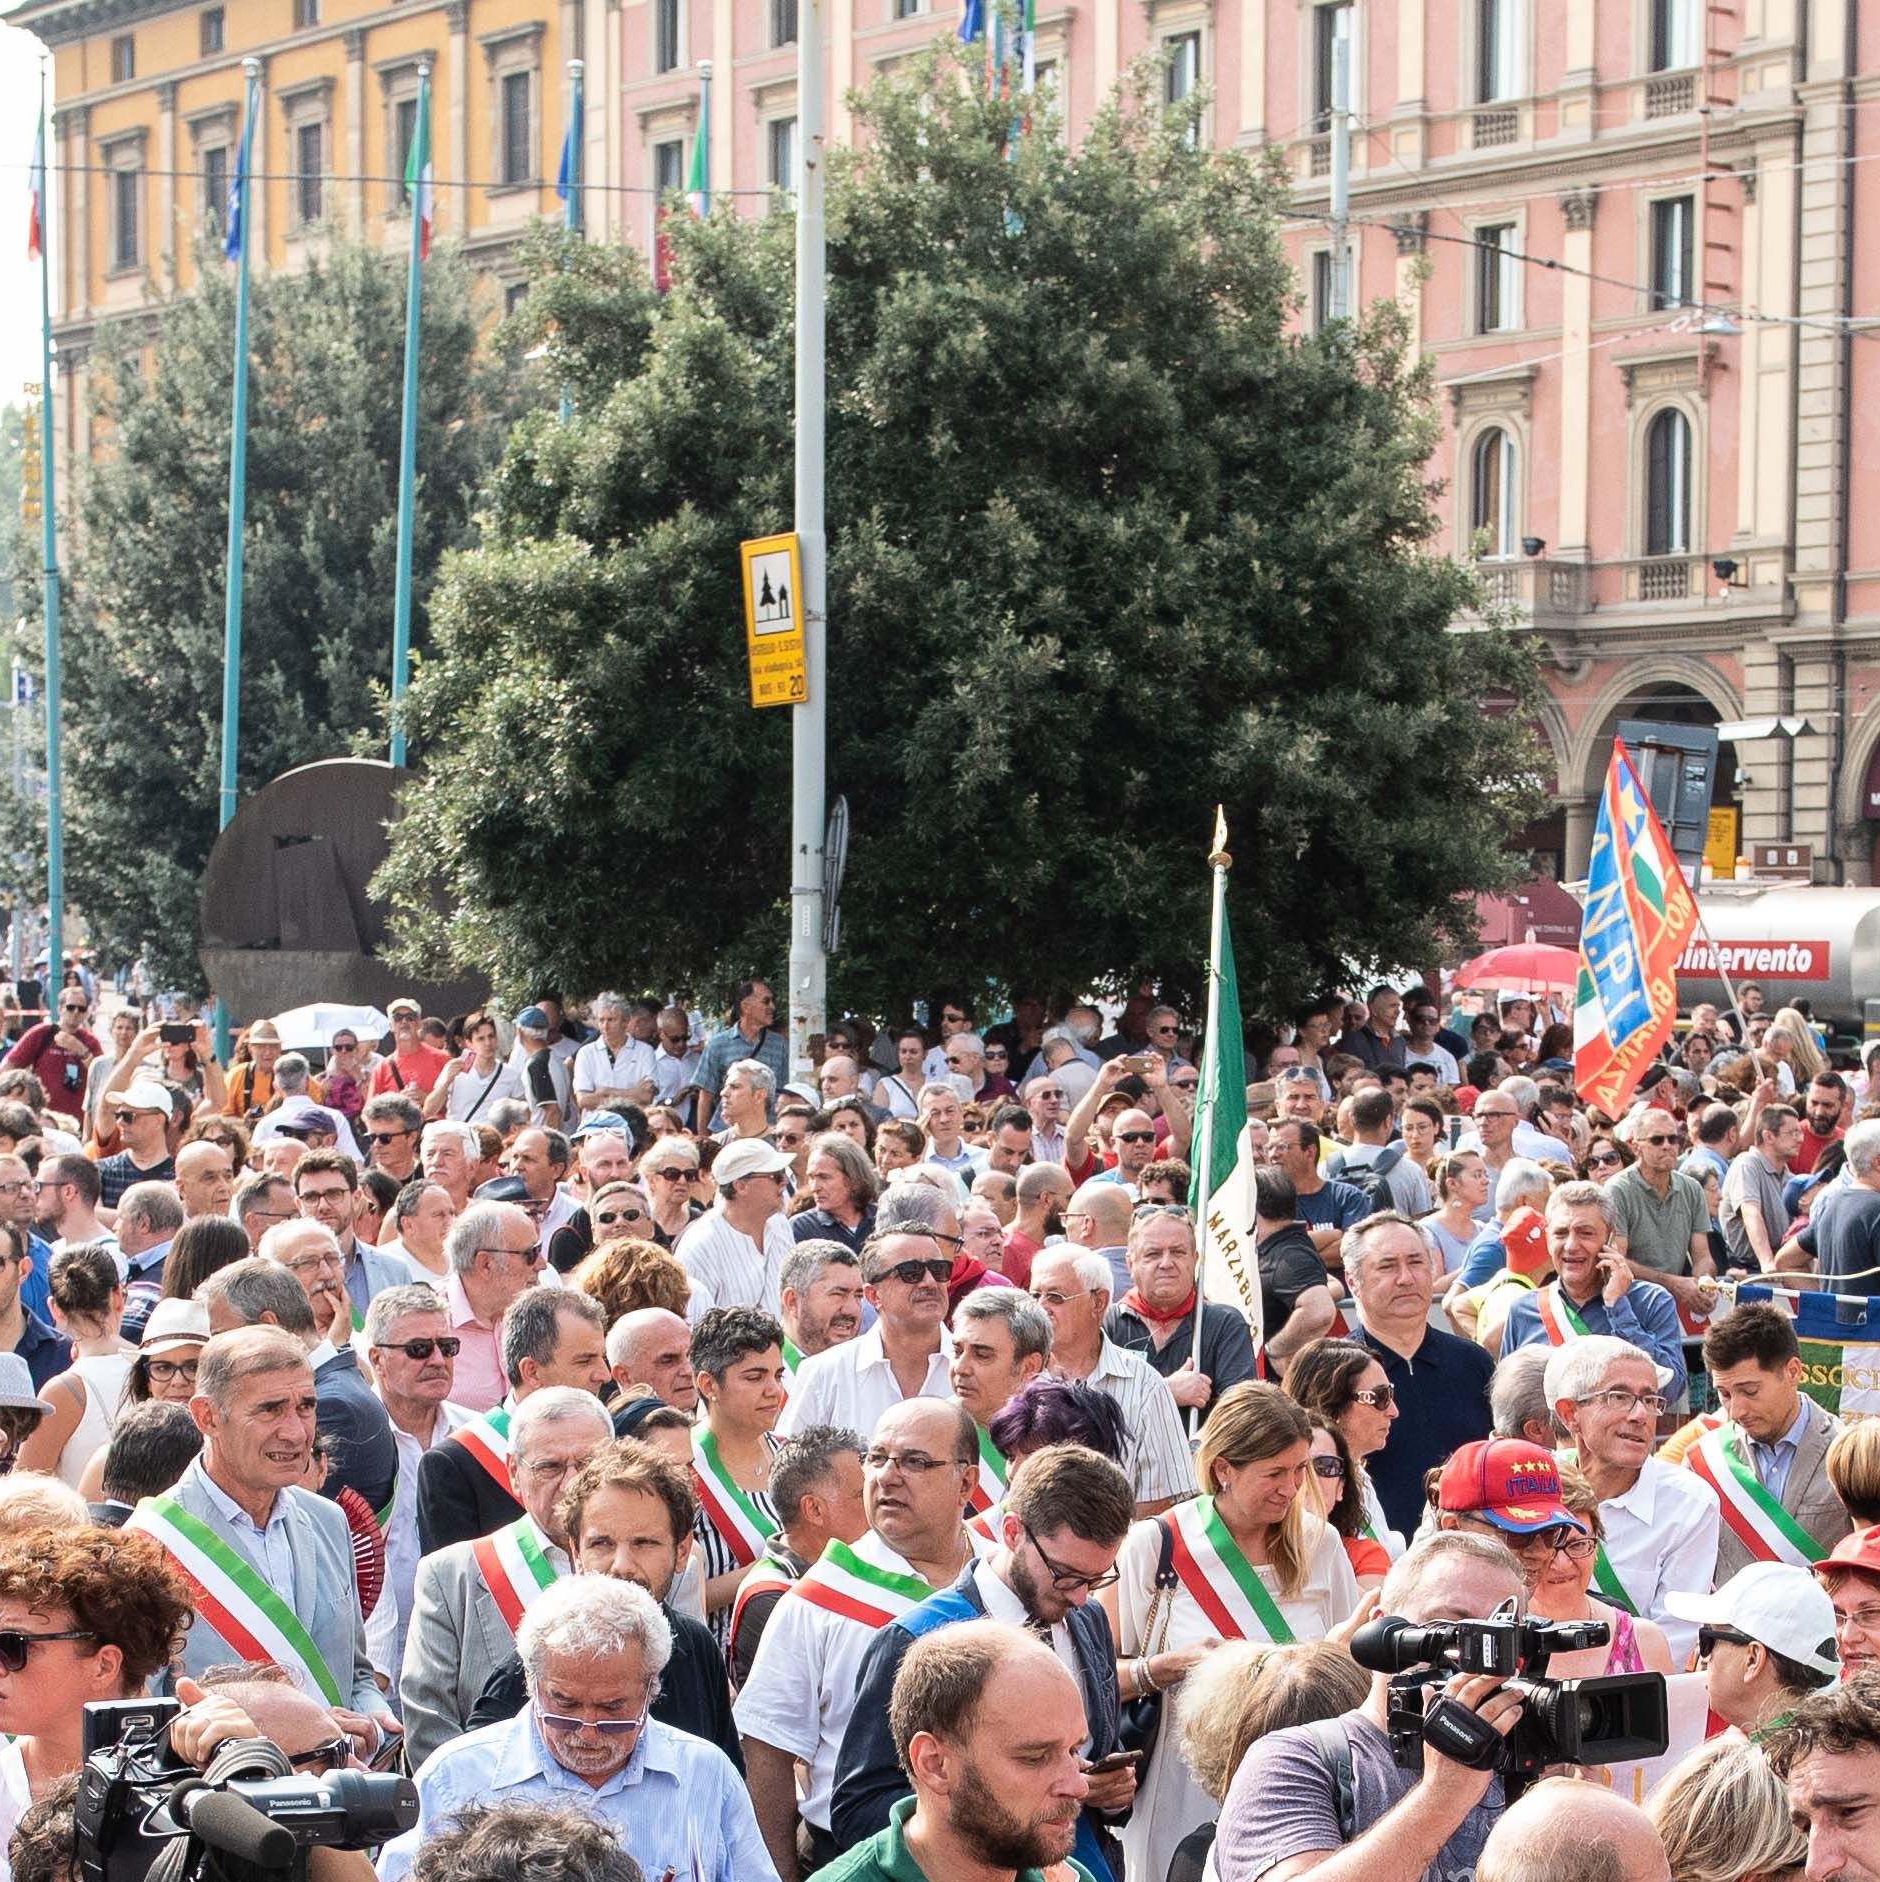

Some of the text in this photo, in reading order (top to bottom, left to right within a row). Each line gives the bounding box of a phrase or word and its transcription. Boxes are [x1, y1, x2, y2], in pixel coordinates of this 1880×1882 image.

[788, 674, 803, 697] 20
[1439, 1714, 1474, 1746] Panasonic
[269, 1798, 312, 1809] Panasonic
